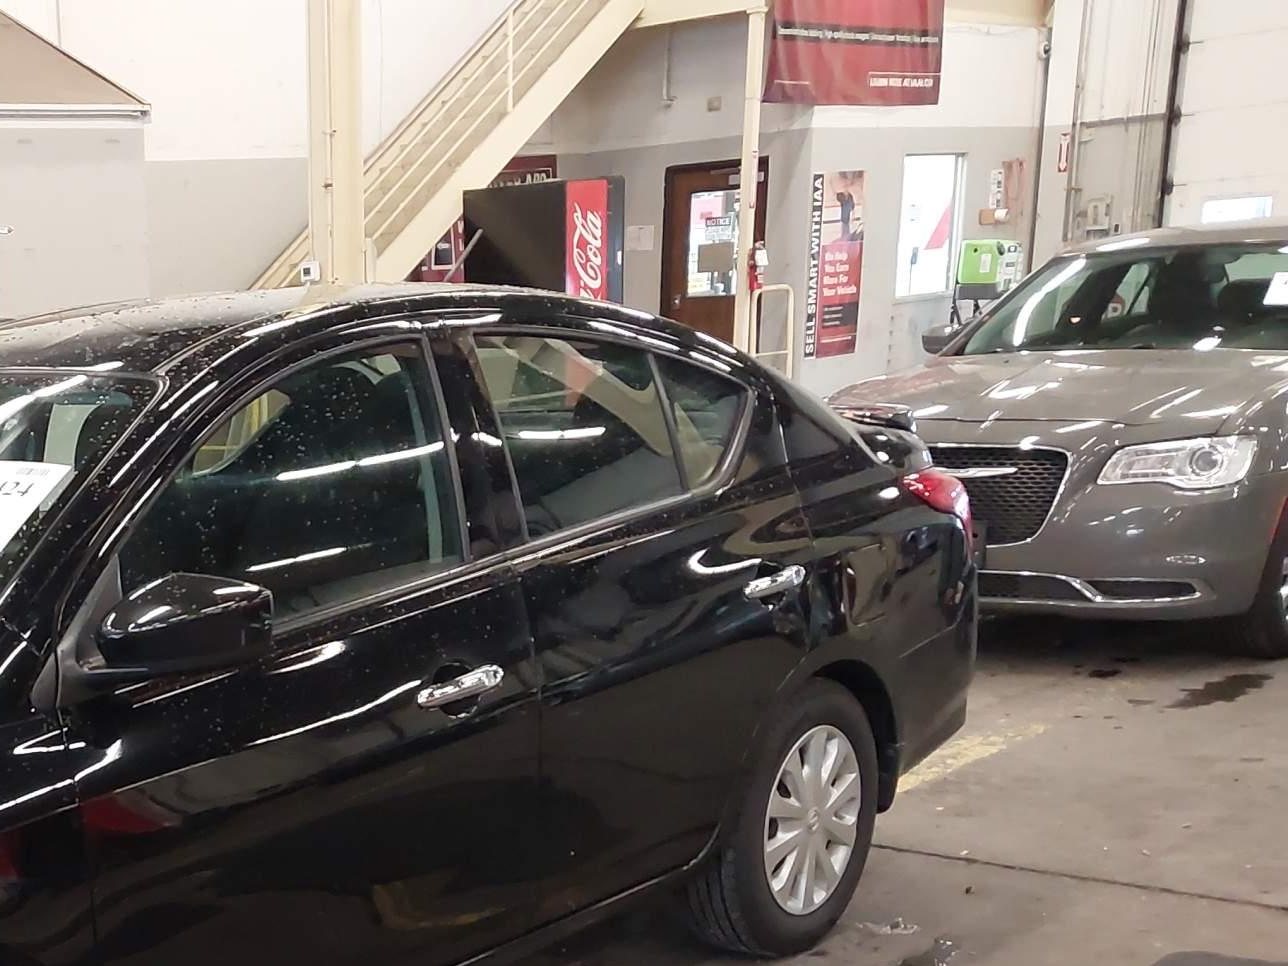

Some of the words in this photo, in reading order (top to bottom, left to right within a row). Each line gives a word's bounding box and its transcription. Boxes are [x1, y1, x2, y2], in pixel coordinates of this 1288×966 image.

[813, 177, 824, 206] IAA
[810, 211, 821, 250] WITH
[807, 261, 819, 314] SMART
[805, 321, 816, 354] SELL
